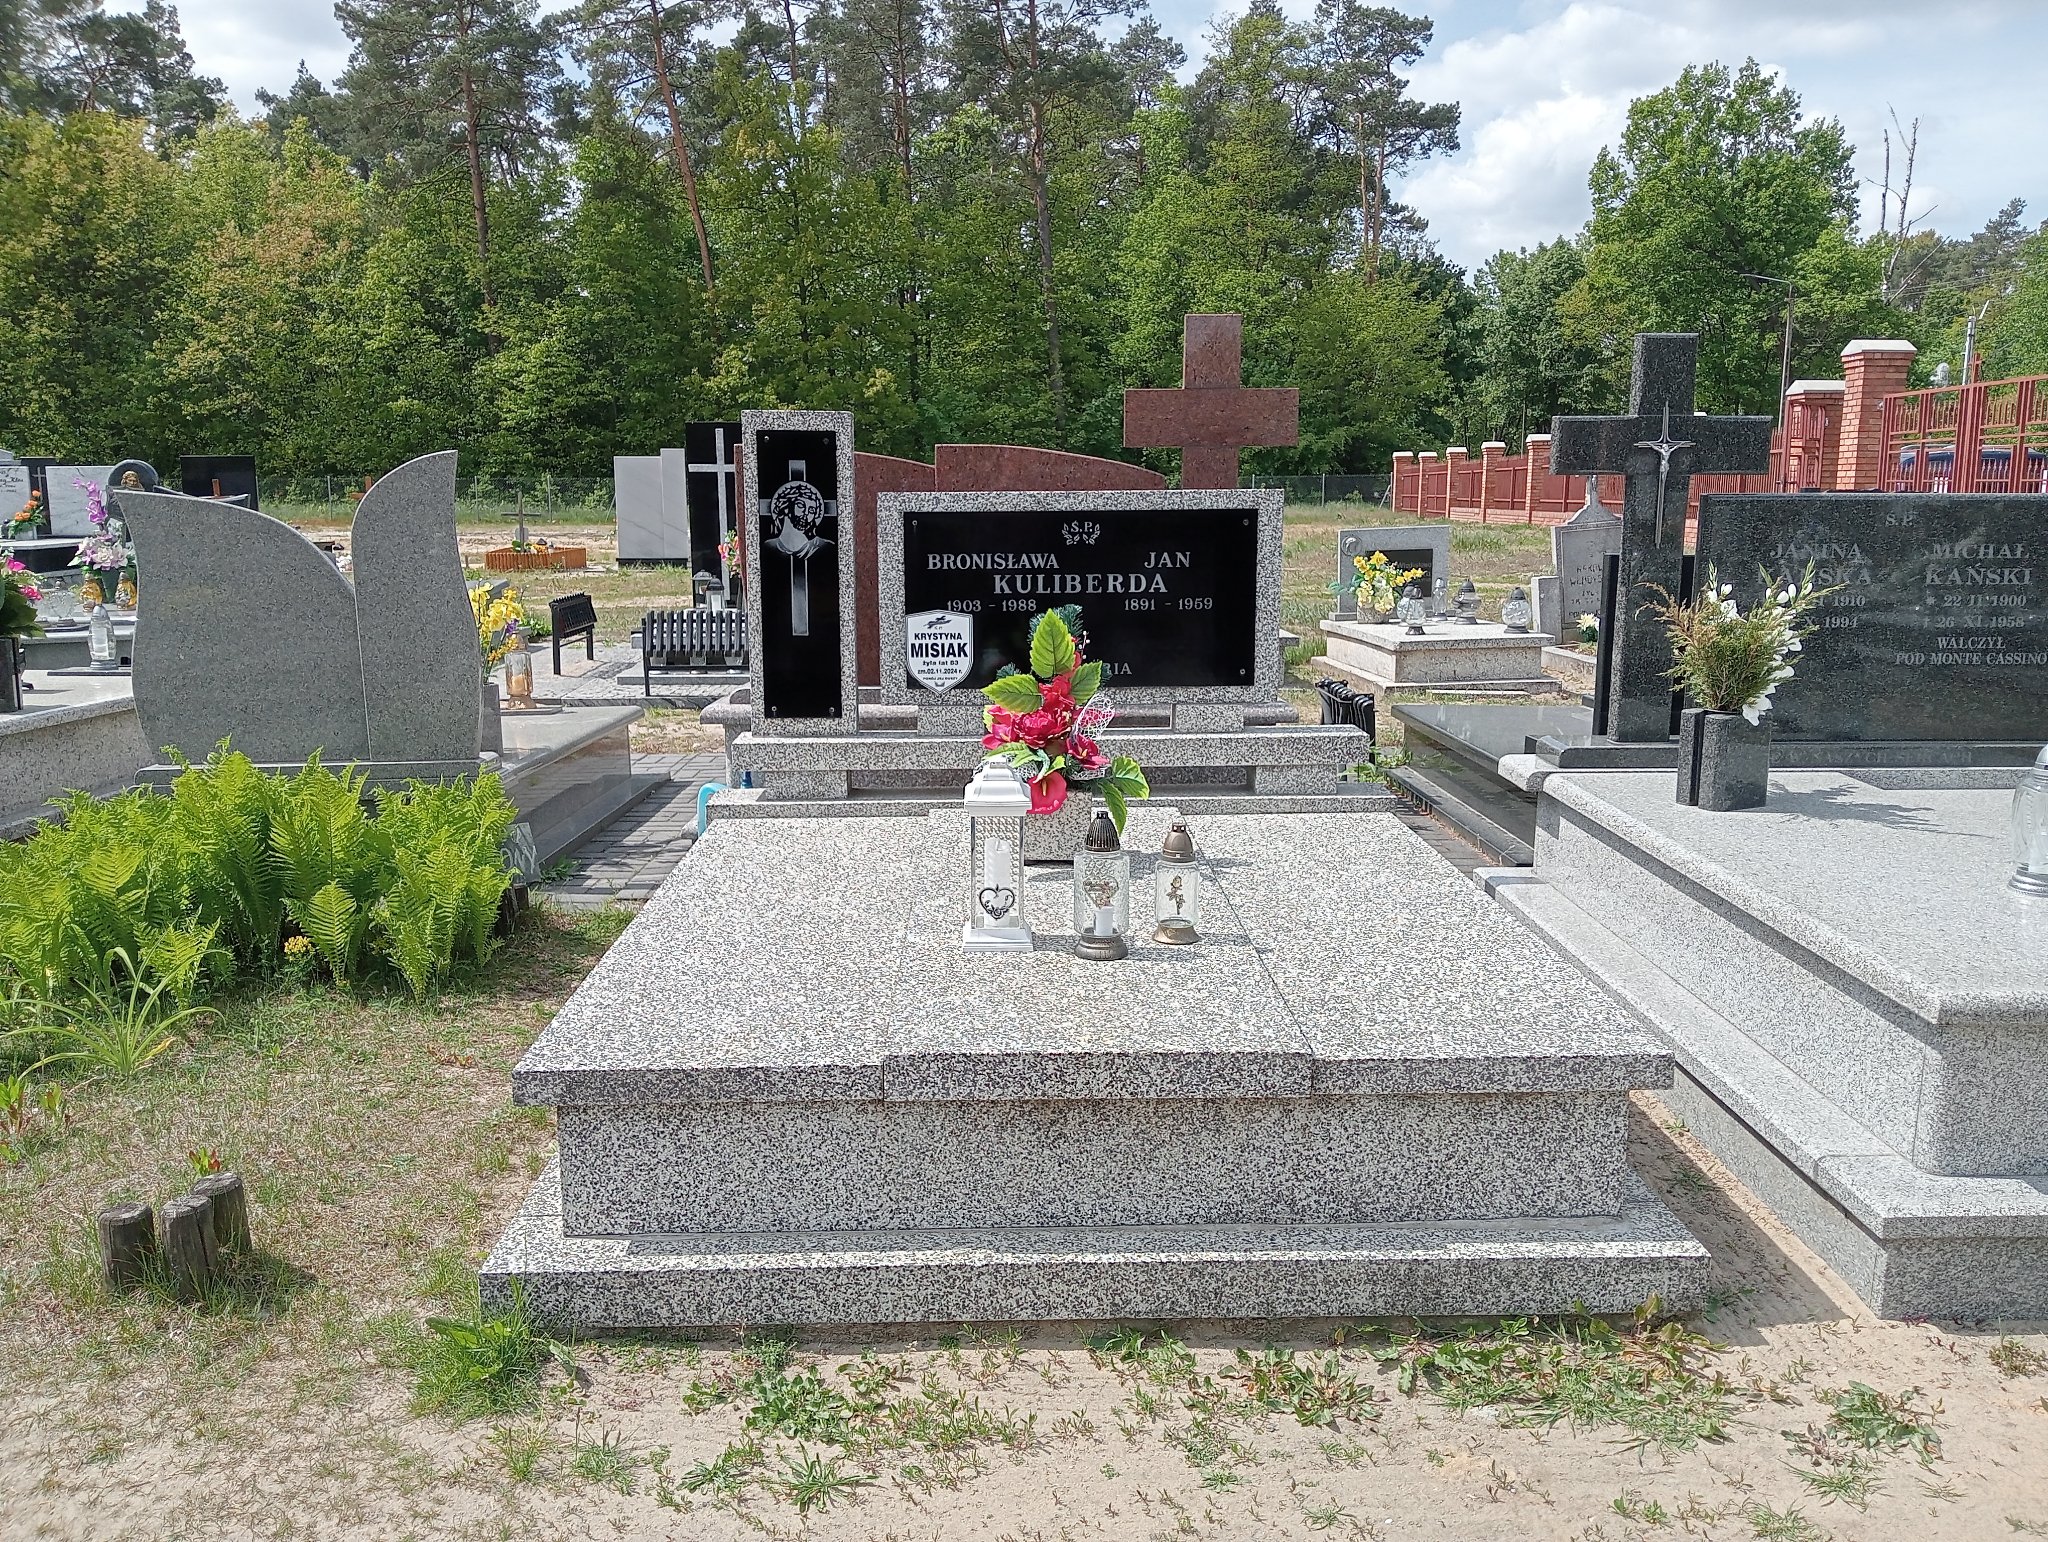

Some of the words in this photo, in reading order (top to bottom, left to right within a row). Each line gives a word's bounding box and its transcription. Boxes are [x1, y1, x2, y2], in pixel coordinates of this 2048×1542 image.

[1770, 543, 1862, 559] JANINA
[1929, 543, 2030, 559] MICHAŁ
[927, 552, 1060, 570] BRONISŁAWA
[1144, 551, 1191, 568] JAN
[1925, 563, 2033, 585] KAŃSKI
[993, 573, 1168, 594] KULIBERDA
[946, 599, 982, 612] 1903
[1002, 599, 1037, 612] 1988
[1124, 598, 1156, 611] 1891
[1178, 597, 1213, 610] 1959
[1832, 595, 1866, 607] 1910
[1943, 594, 1962, 607] 22
[1989, 594, 2027, 607] 1900
[1823, 616, 1859, 628] 1994
[1934, 616, 1956, 628] 26
[1989, 616, 2026, 628] 1958
[914, 632, 963, 641] KRYSTYNA
[910, 642, 968, 658] MISIAK
[1894, 652, 1926, 666] POD
[1929, 652, 1982, 667] MONTE
[1986, 651, 2048, 666] CASSINO
